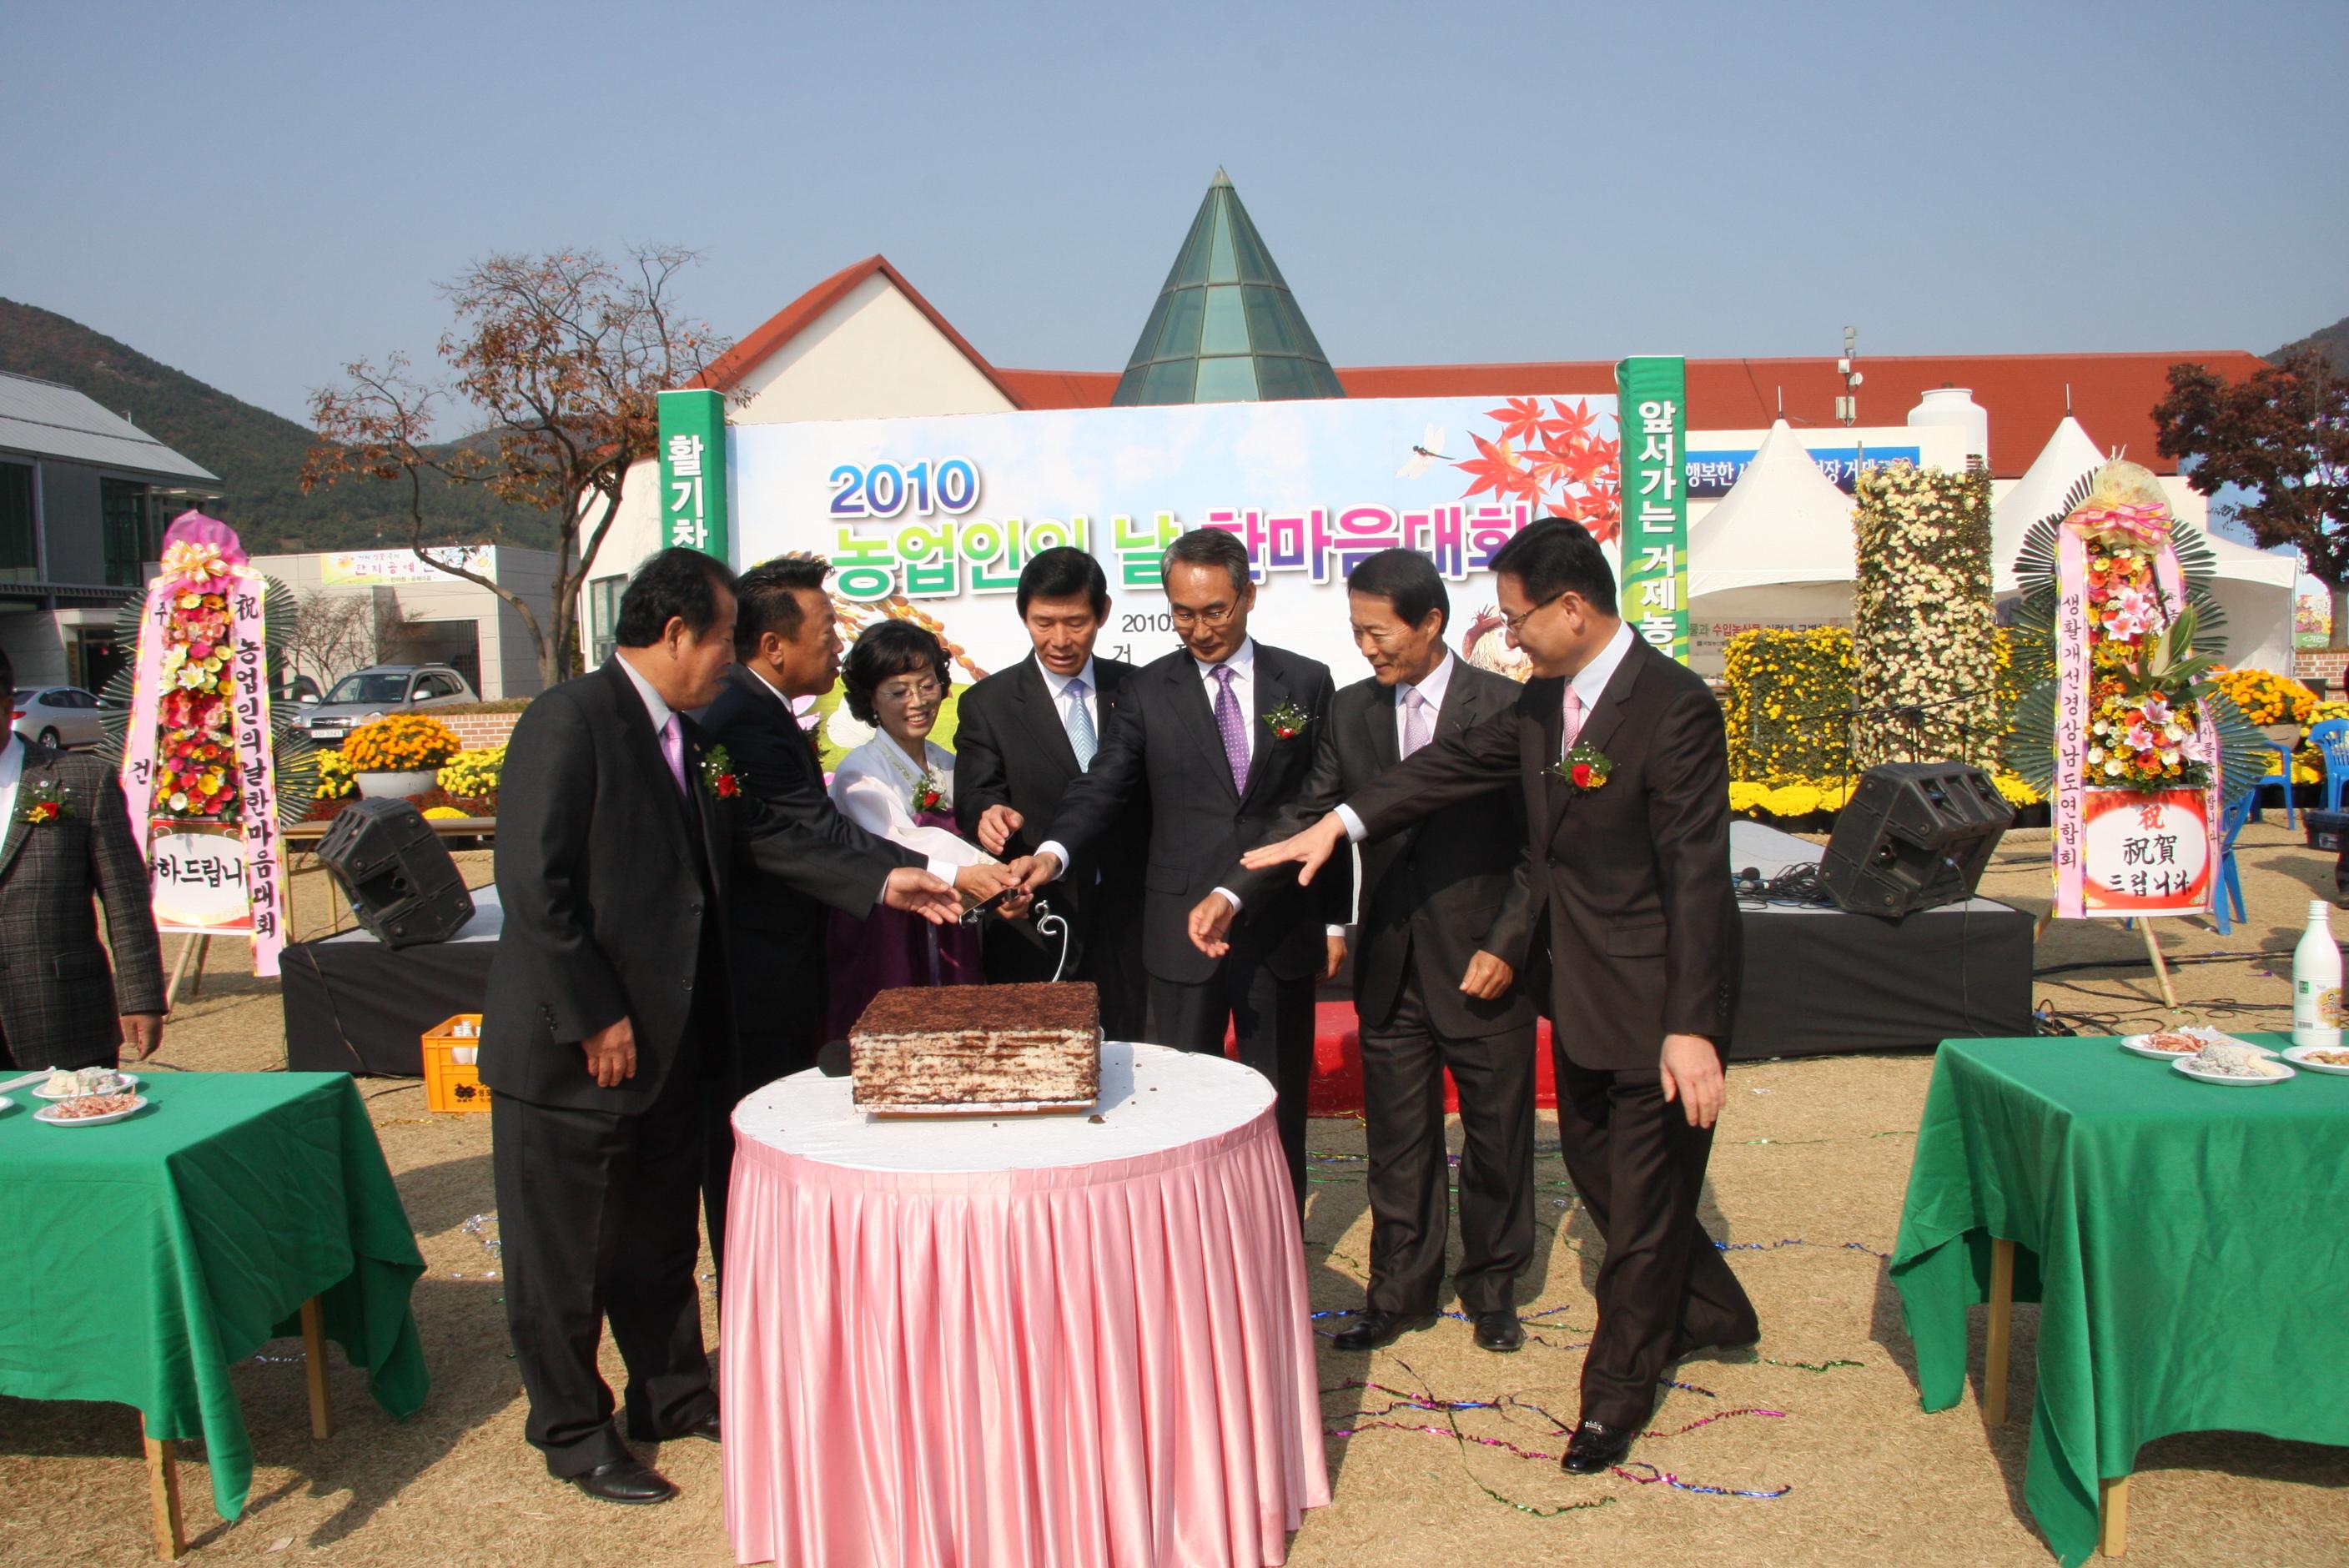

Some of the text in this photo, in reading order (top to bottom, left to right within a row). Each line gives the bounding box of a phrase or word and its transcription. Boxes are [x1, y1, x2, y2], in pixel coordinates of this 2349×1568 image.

[1638, 400, 1677, 533] 앞서가는
[1686, 462, 1734, 486] 행복한
[828, 458, 978, 515] 2010
[234, 593, 259, 621] 祝
[2137, 804, 2165, 831] 祝
[2122, 834, 2178, 866] 祝賀
